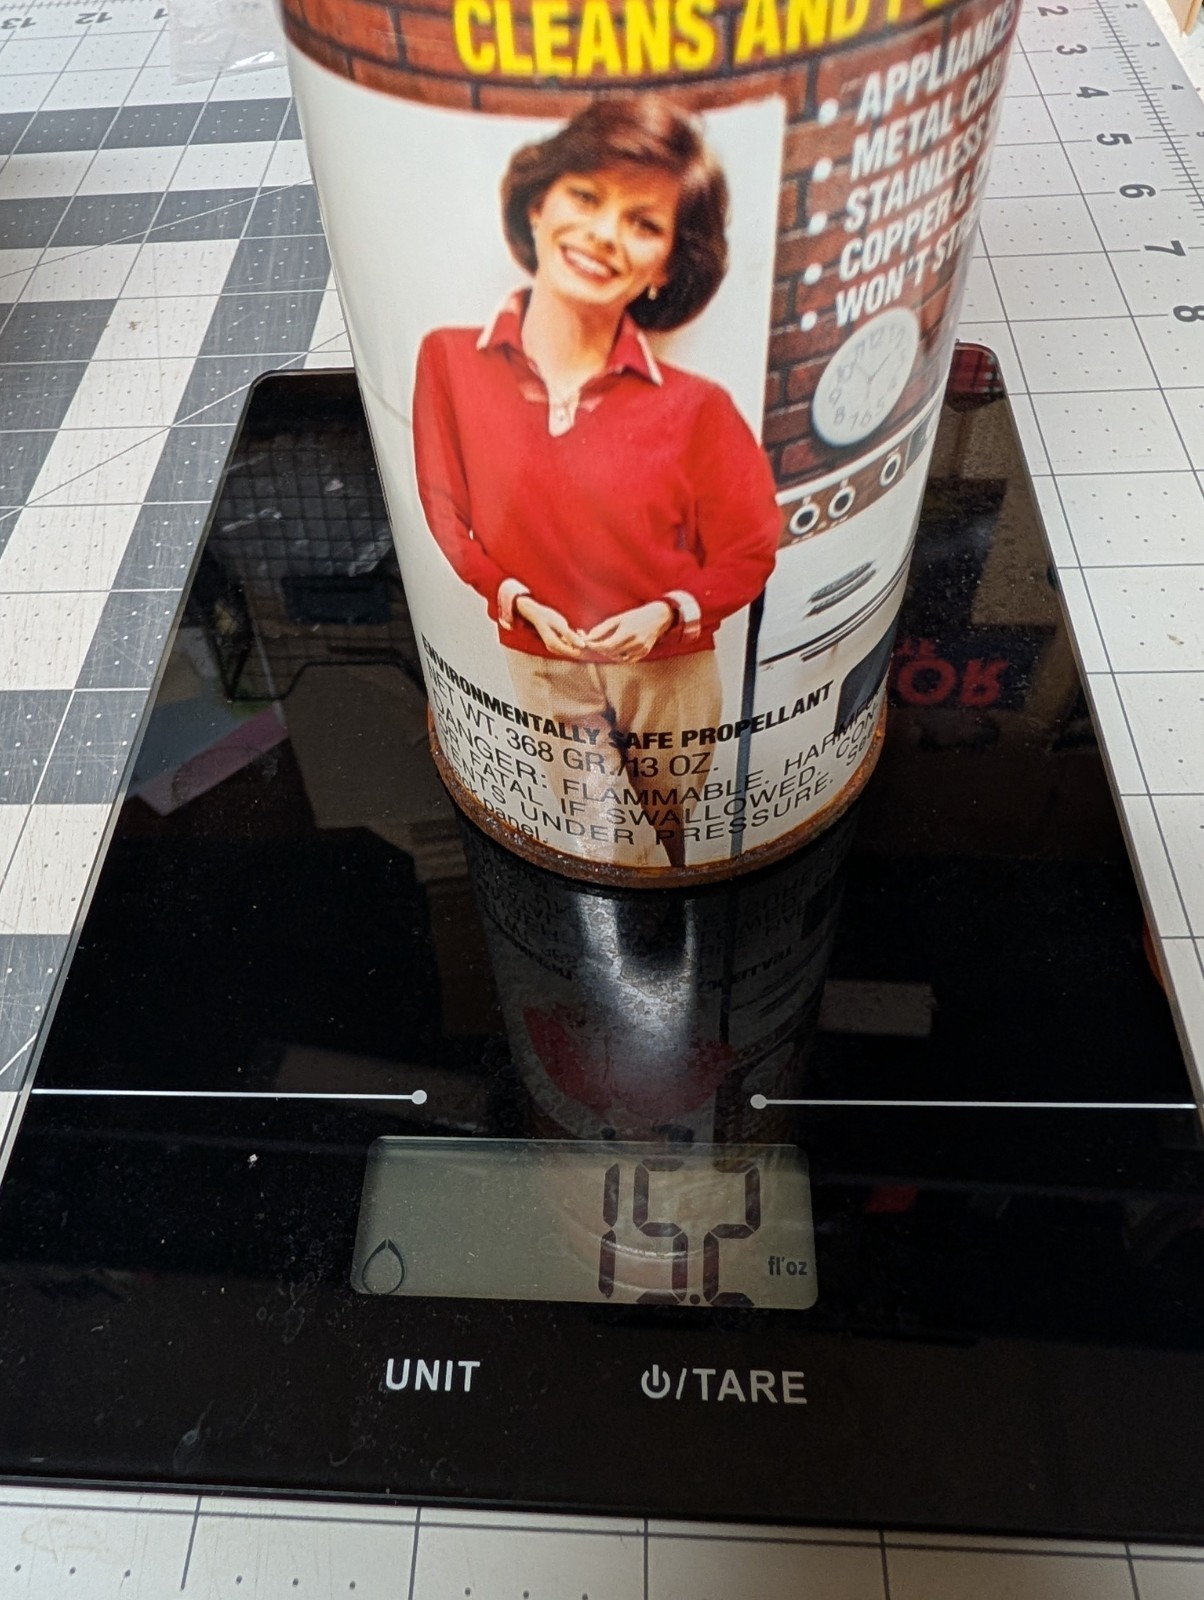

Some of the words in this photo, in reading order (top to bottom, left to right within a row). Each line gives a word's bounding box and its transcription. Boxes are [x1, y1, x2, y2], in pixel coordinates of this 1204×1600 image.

[1, 17, 37, 30] 13
[75, 11, 112, 25] 12
[1038, 5, 1069, 17] 2
[452, 0, 716, 78] CLEANS
[734, 0, 871, 62] AND
[1056, 44, 1088, 56] 3
[1076, 86, 1110, 99] 4
[850, 92, 954, 183] METAL
[1096, 132, 1133, 146] 5
[1119, 183, 1156, 199] 6
[837, 189, 953, 281] COPPER
[1144, 240, 1186, 257] 7
[835, 245, 930, 327] WON'T
[1173, 305, 1204, 322] 8
[421, 632, 600, 745] ENVIRONMENTALLY
[608, 730, 673, 751] SAFE
[681, 680, 834, 748] PROPELLANT
[426, 656, 455, 706] NET
[459, 695, 500, 740] WT.
[506, 727, 554, 763] 368
[669, 752, 720, 776] OZ.
[433, 687, 547, 789] DANGER:
[563, 769, 769, 806] FLAMMABLE.
[469, 750, 544, 807] FATAL
[561, 797, 588, 817] IF
[607, 766, 822, 827] SWALLOWED.
[521, 801, 635, 846] UNDER
[656, 771, 833, 845] PRESSURE.
[385, 1358, 481, 1392] UNIT
